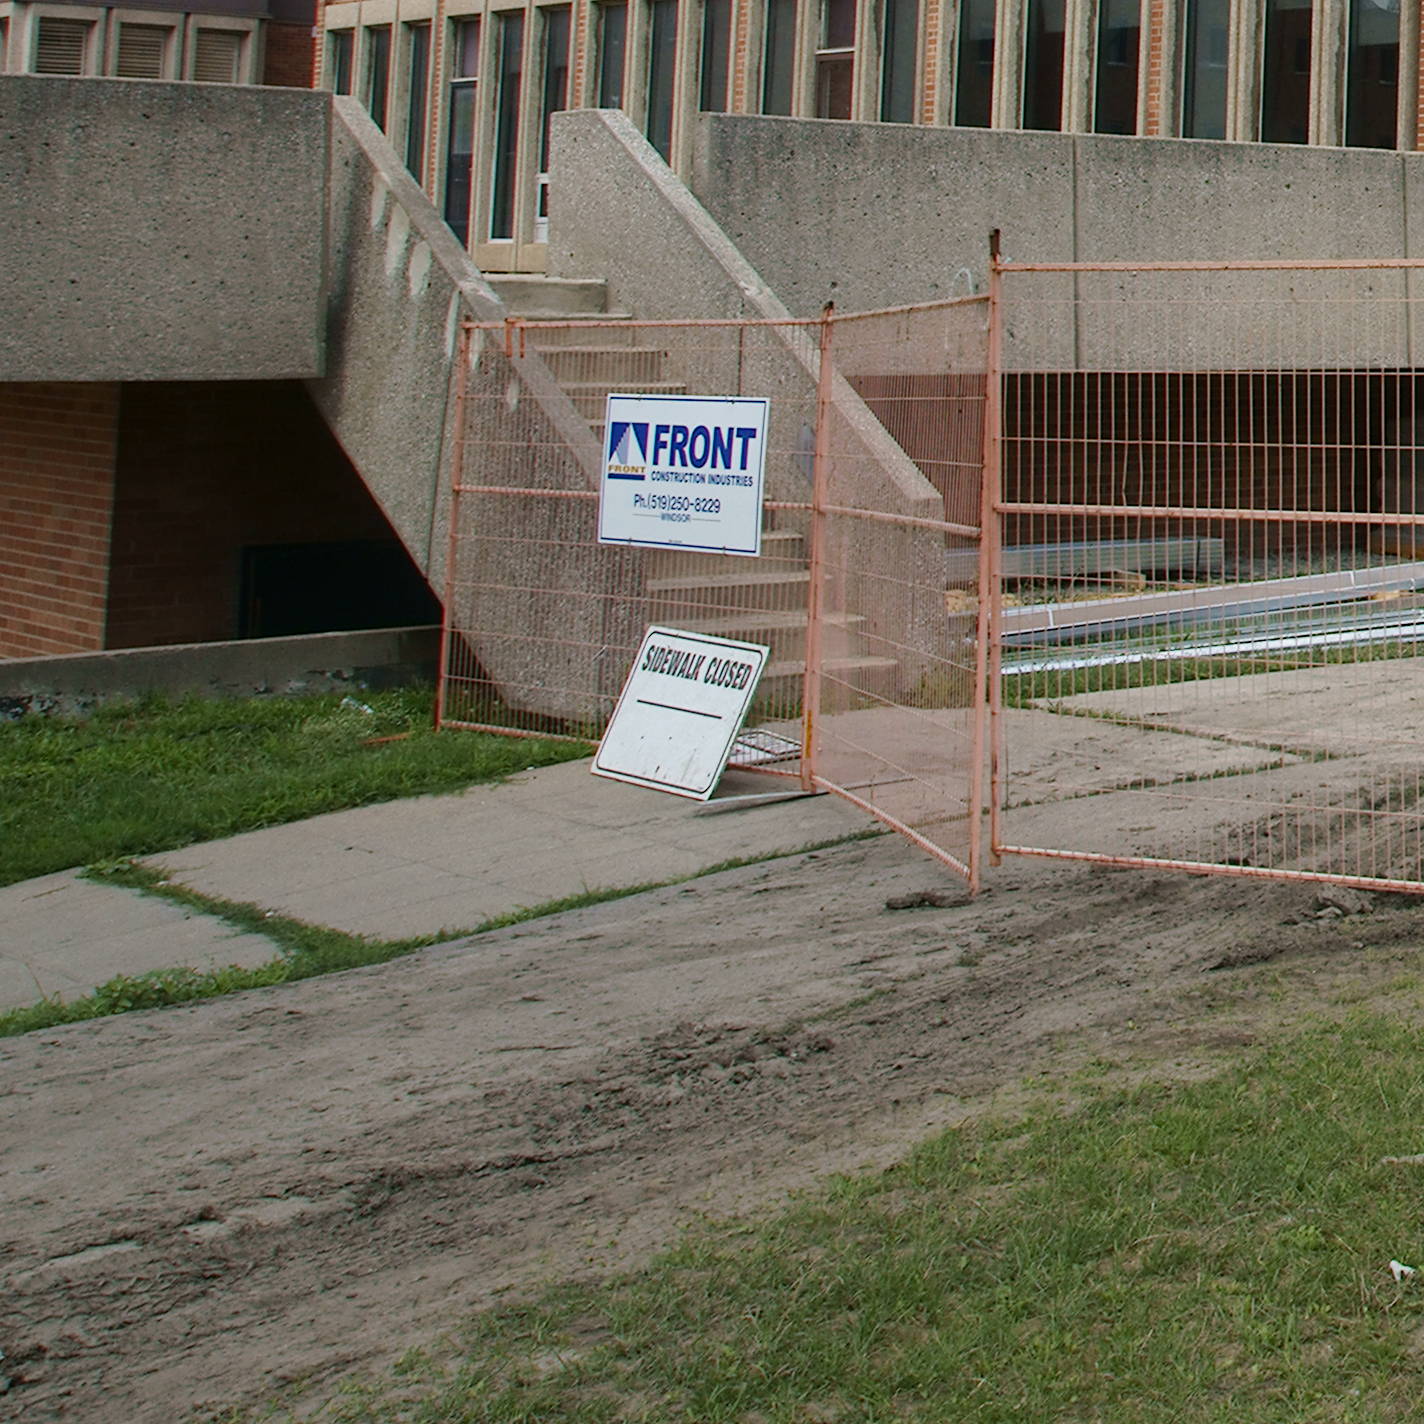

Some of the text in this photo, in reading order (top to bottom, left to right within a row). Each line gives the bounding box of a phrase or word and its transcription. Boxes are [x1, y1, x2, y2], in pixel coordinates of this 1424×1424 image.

[652, 424, 757, 471] FRONT
[607, 465, 647, 474] FRONT
[651, 470, 754, 487] CONSTRUCTION INDUSTRIES
[641, 645, 753, 691] SIDEWALK CLOSED
